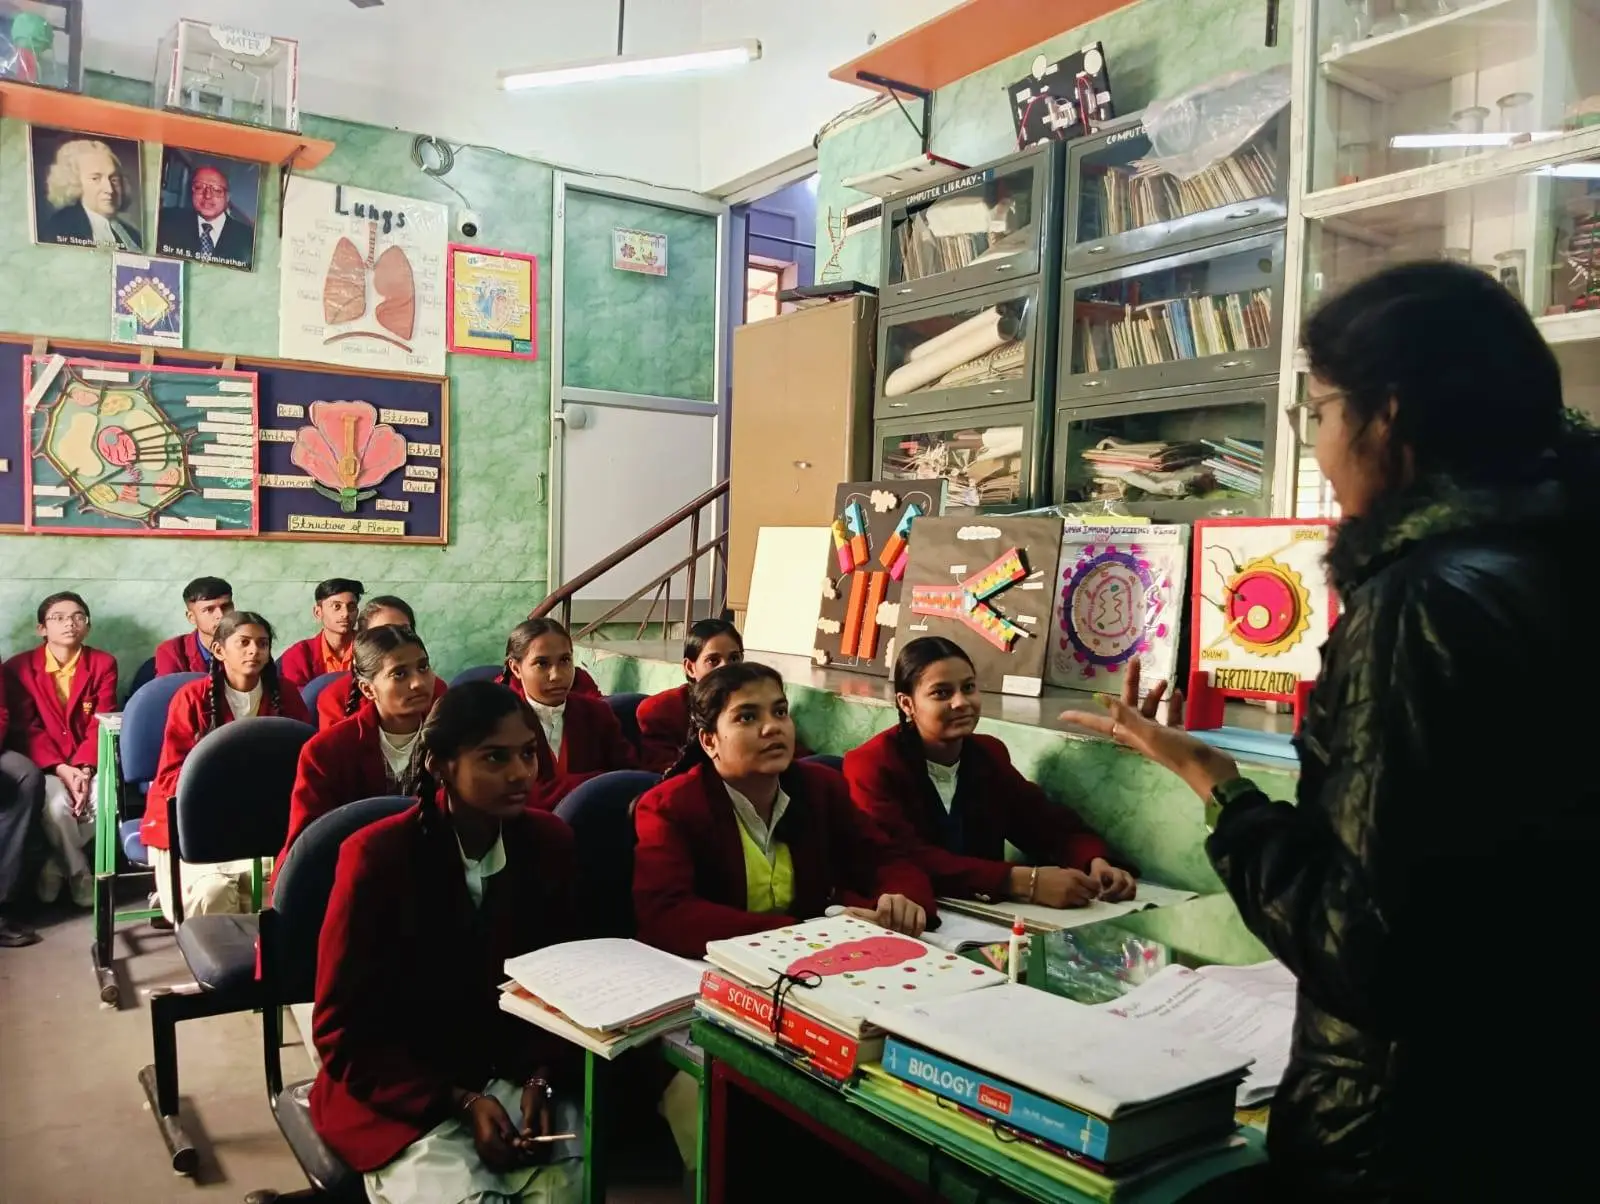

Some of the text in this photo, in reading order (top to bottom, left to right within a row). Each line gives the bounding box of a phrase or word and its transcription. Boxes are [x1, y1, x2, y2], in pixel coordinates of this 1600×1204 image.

[906, 187, 941, 205] COMPUTER
[56, 235, 68, 244] Sir
[162, 244, 175, 253] Sir
[408, 444, 440, 457] Style
[291, 515, 346, 530] Structure
[350, 521, 362, 533] of
[1214, 667, 1302, 694] FERTILIZATIO
[908, 1056, 975, 1098] BIOLOGY
